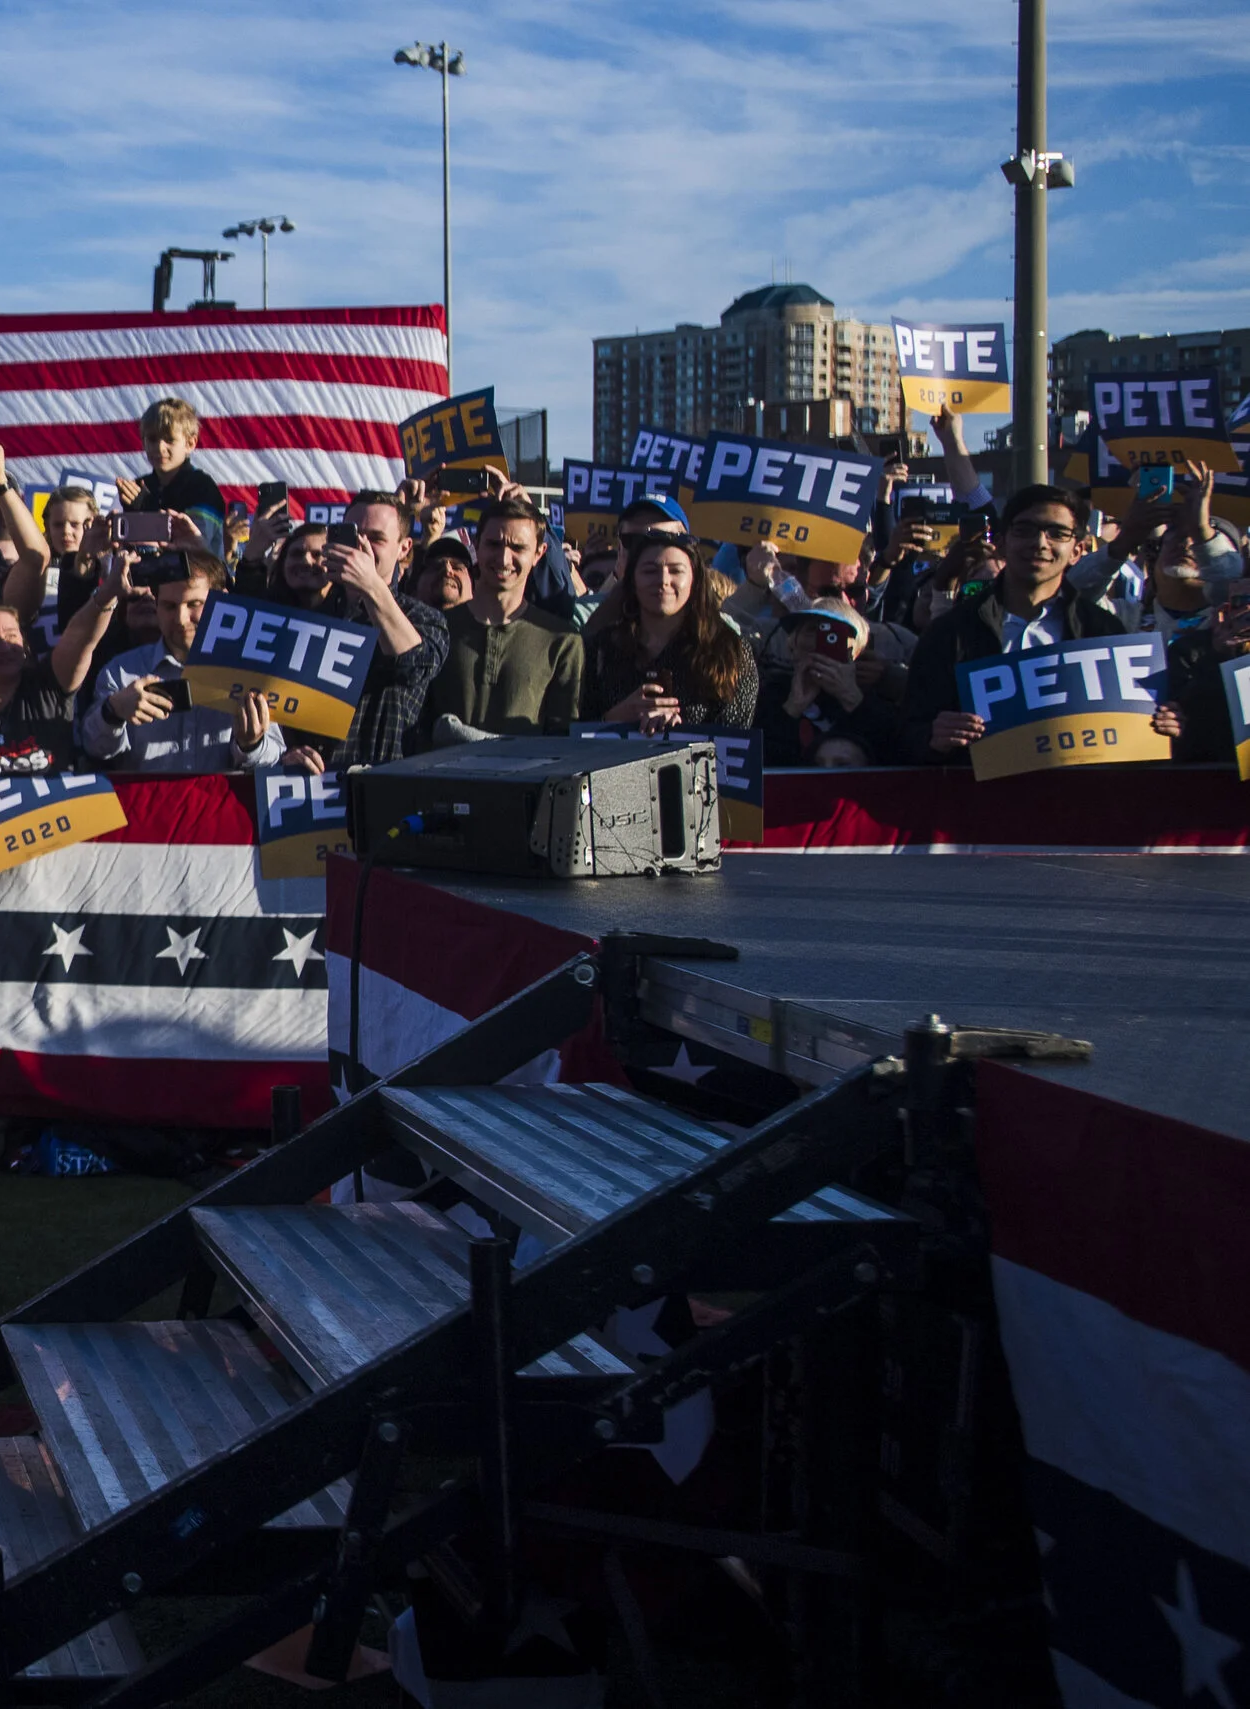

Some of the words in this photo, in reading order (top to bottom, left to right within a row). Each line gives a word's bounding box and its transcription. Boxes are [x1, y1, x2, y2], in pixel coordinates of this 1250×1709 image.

[895, 324, 998, 373] PETE
[919, 388, 963, 404] 2020
[1094, 379, 1215, 430] PETE
[402, 396, 492, 475] PETE
[630, 430, 705, 482] PETE
[567, 465, 673, 508] PETE
[706, 440, 872, 516] PETE
[739, 515, 810, 543] 2020
[200, 601, 366, 690] PETE
[968, 644, 1158, 723] PETE
[1035, 728, 1118, 754] 2020
[266, 772, 347, 828] PE
[4, 815, 72, 853] 2020
